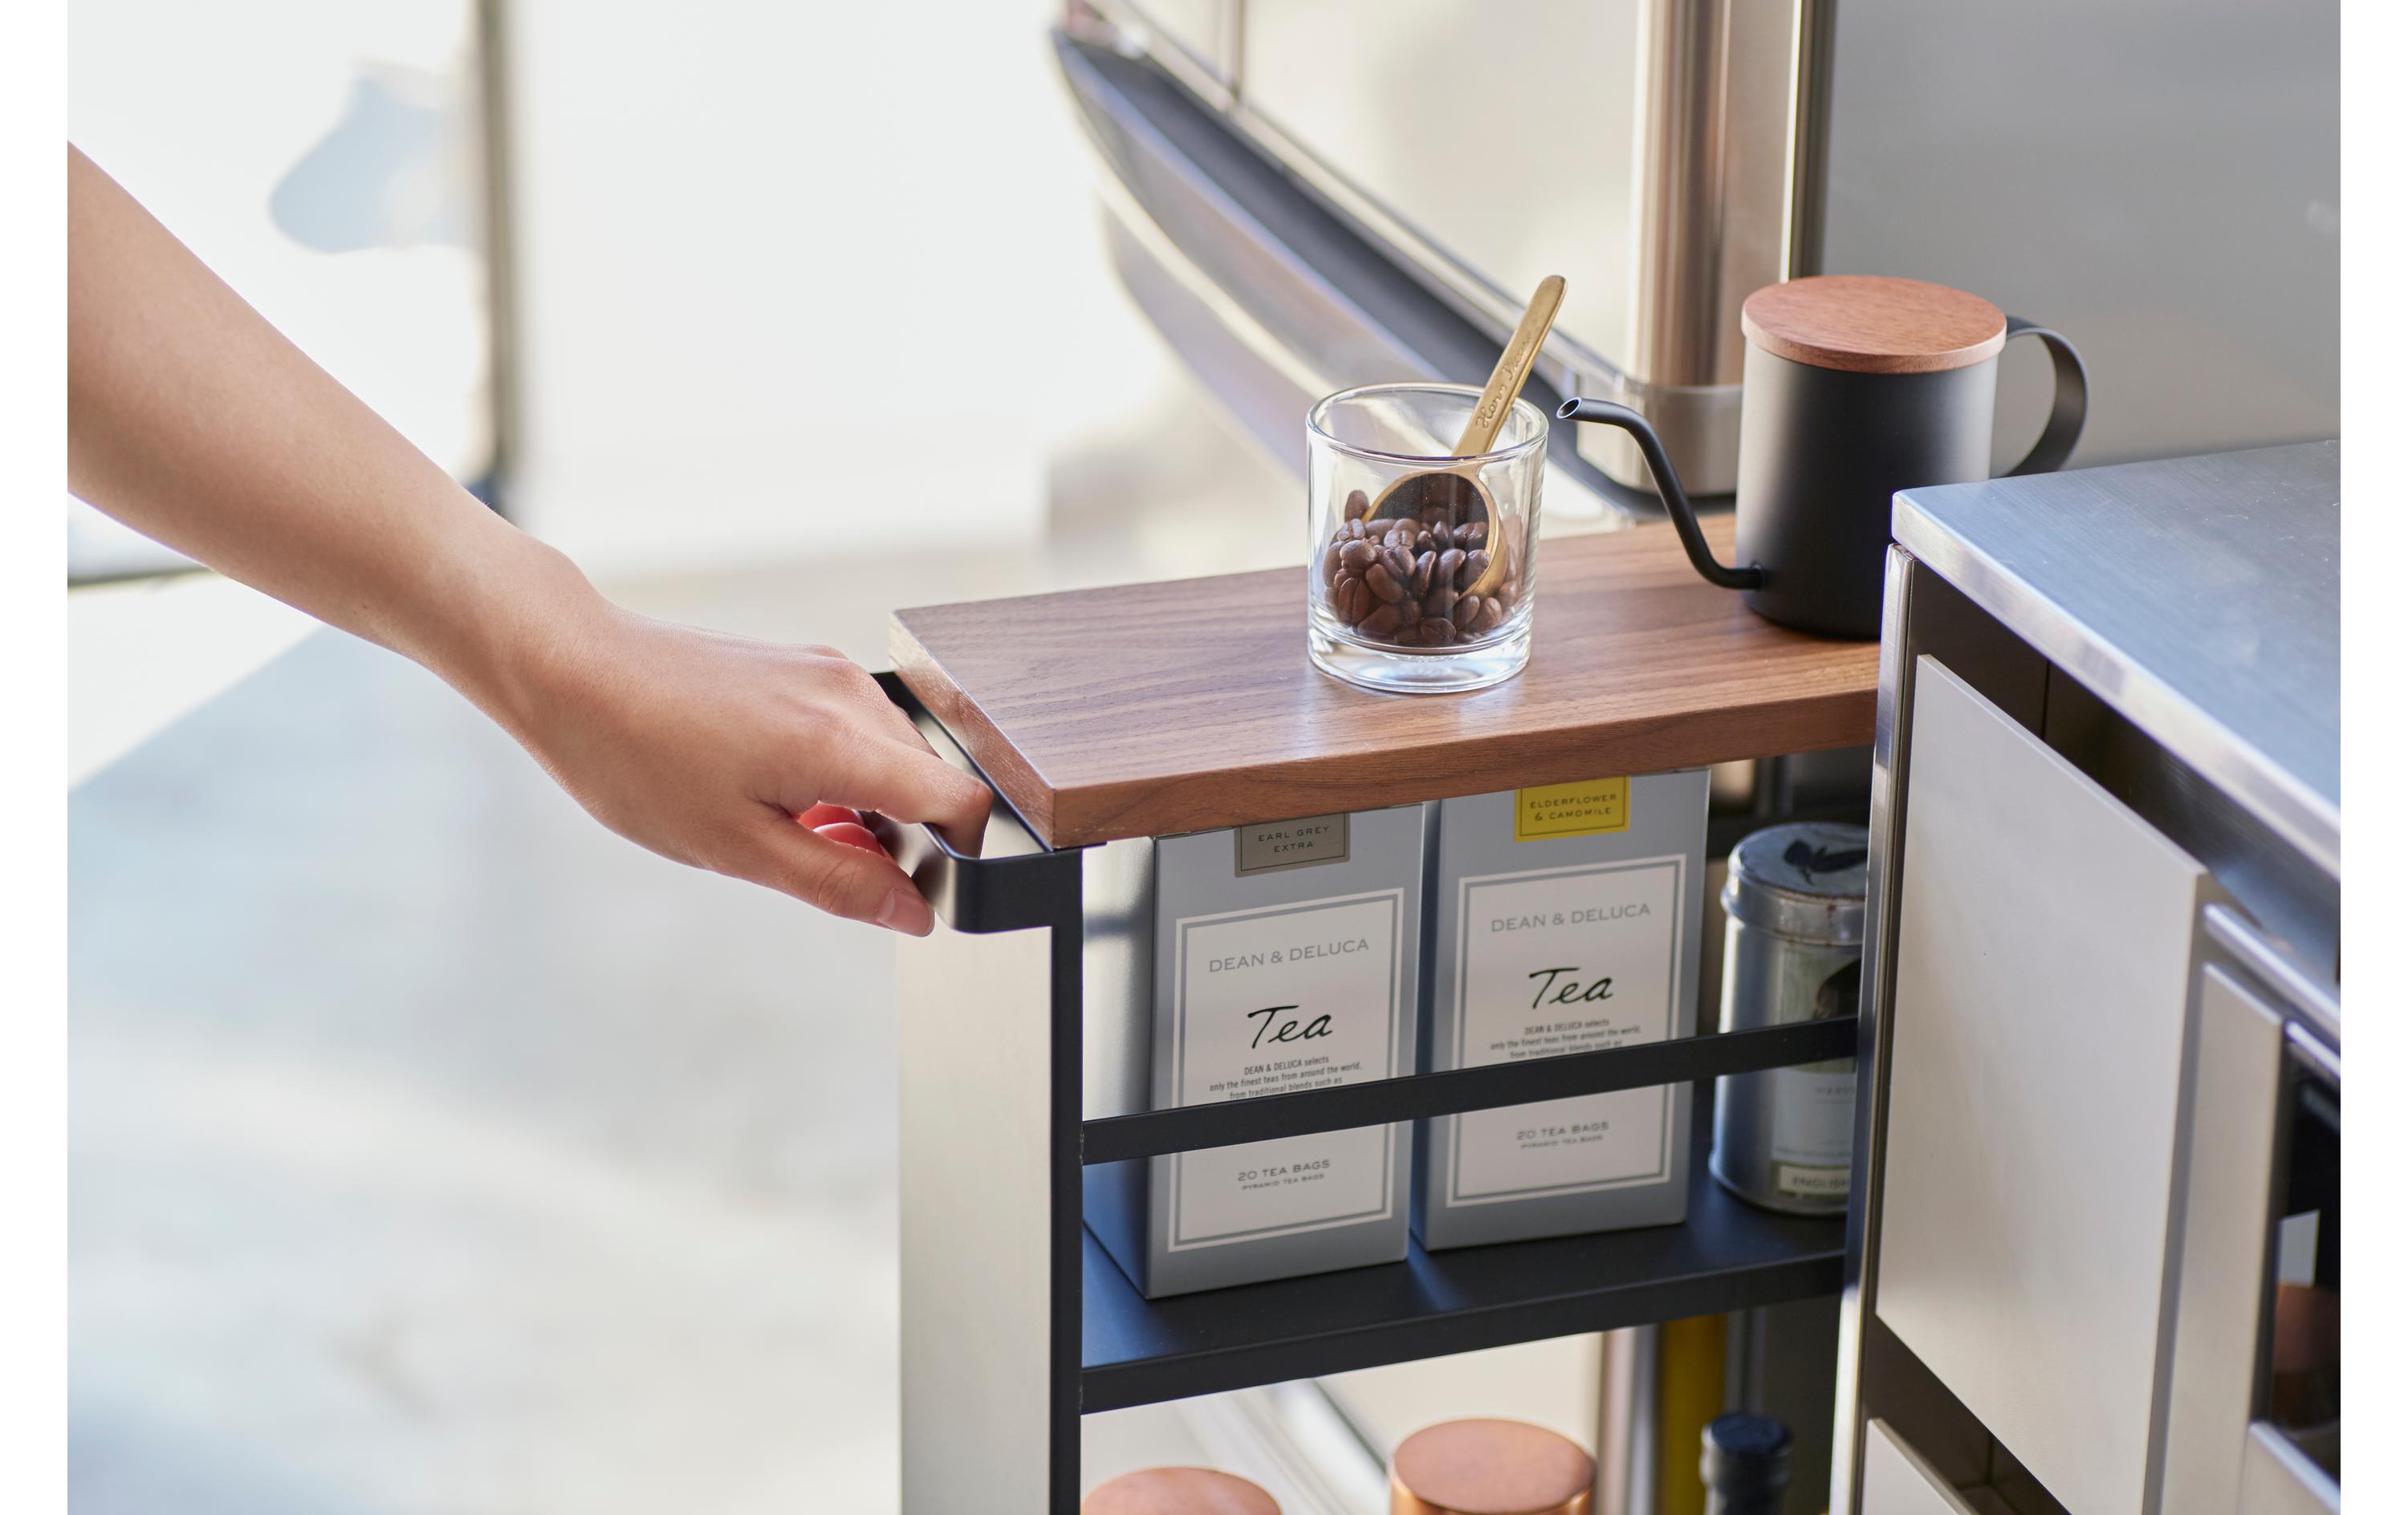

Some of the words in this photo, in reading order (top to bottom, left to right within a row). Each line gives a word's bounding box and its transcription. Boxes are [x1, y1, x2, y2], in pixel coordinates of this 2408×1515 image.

[1530, 794, 1617, 809] ELDERFLOWER
[1535, 812, 1543, 821] &
[1549, 807, 1611, 819] CAMOMILE
[1259, 831, 1290, 842] EARL
[1296, 826, 1329, 836] GREY
[1274, 841, 1314, 852] EXTRA
[1491, 914, 1546, 932] DEAN
[1552, 912, 1565, 925] &
[1571, 903, 1651, 924] DELUCA
[1209, 952, 1264, 973] DEAN
[1271, 950, 1283, 963] &
[1290, 938, 1369, 961] DELUCA
[1528, 968, 1613, 1009] Tea
[1247, 1005, 1332, 1049] Tea
[1244, 1065, 1264, 1075] DEAN
[1266, 1064, 1271, 1072] &
[1274, 1059, 1302, 1071] DELUCA
[1304, 1056, 1329, 1066] selects
[1210, 1083, 1225, 1092] only
[1226, 1080, 1239, 1089] the
[1240, 1077, 1262, 1087] finest
[1263, 1074, 1279, 1084] teas
[1281, 1072, 1298, 1081] from
[1300, 1068, 1324, 1078] around
[1327, 1065, 1338, 1074] the
[1230, 1091, 1247, 1099] from
[1248, 1086, 1287, 1099] traditional
[1288, 1082, 1312, 1091] blends
[1516, 1130, 1537, 1140] 20
[1541, 1127, 1566, 1136] TEA
[1572, 1122, 1609, 1134] BAGS
[1238, 1171, 1258, 1181] 20
[1262, 1167, 1287, 1177] TEA
[1293, 1160, 1330, 1173] BAGS
[1302, 1173, 1324, 1183] BAGS
